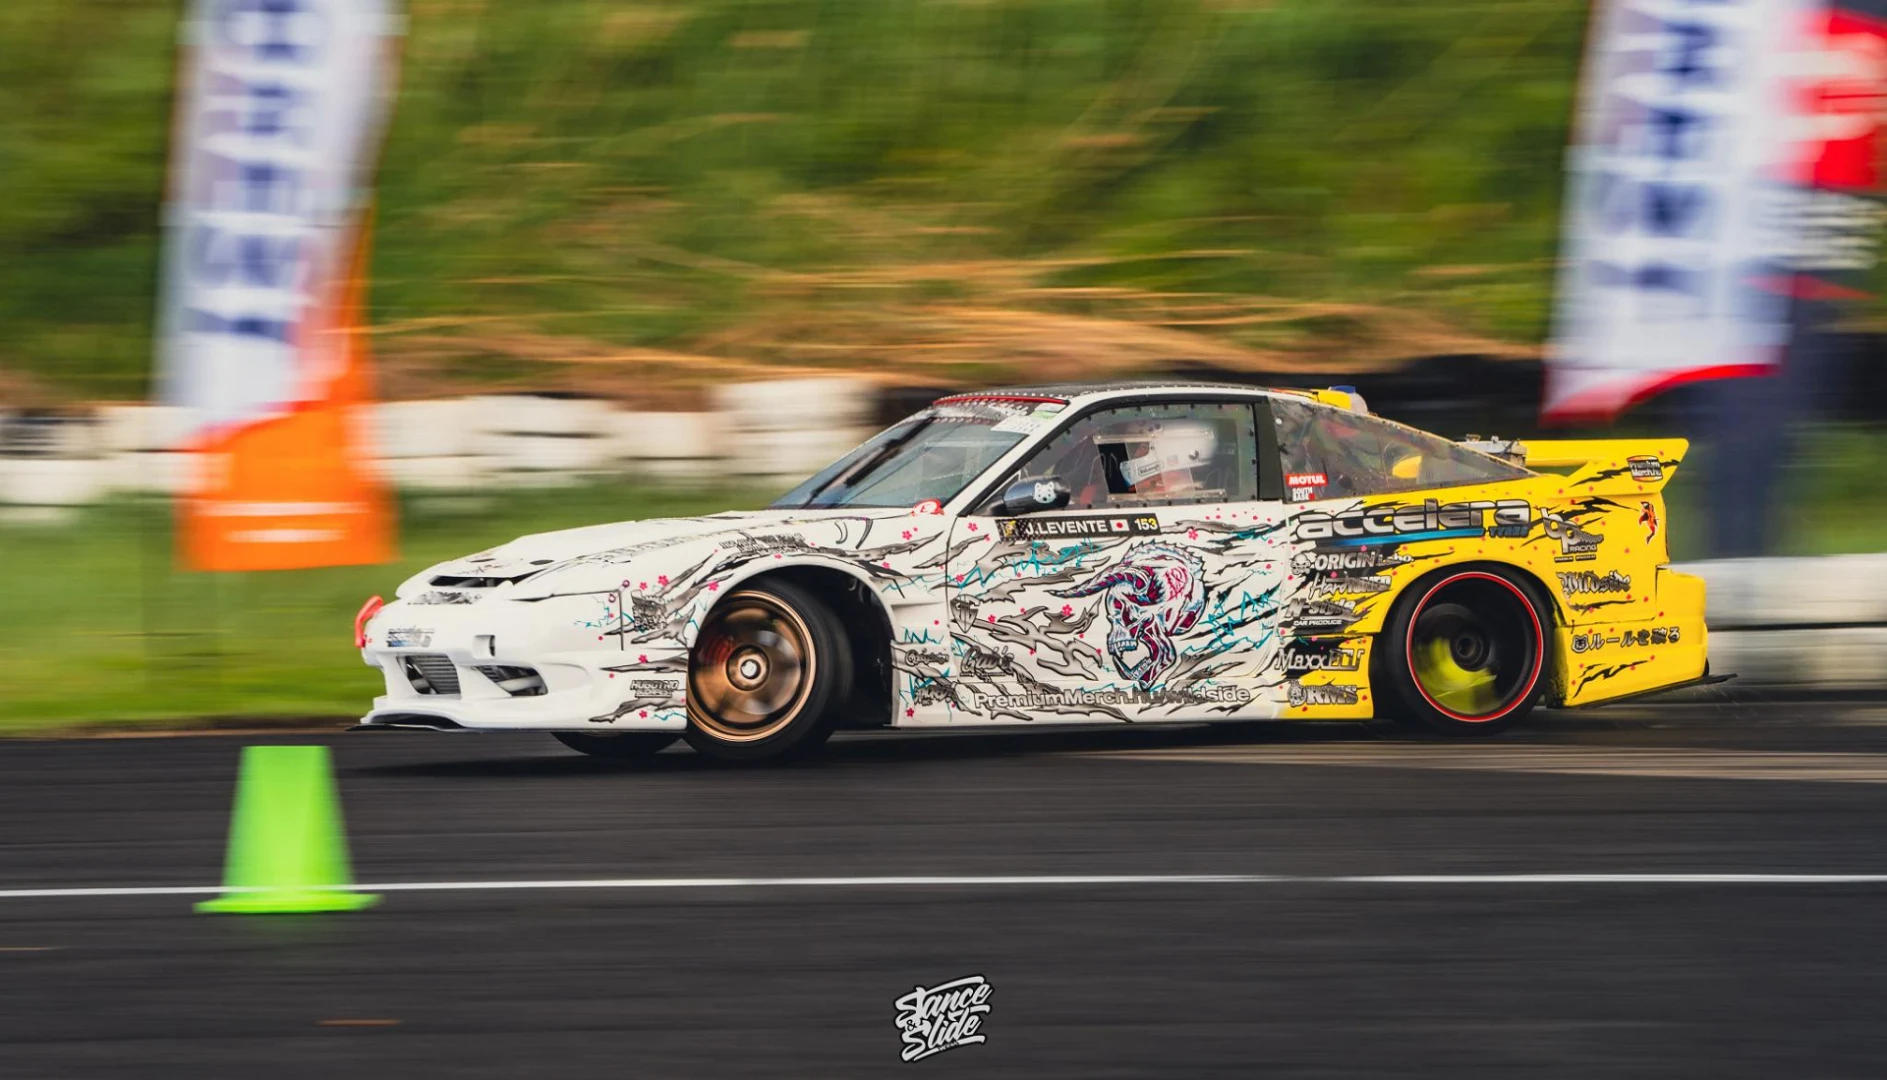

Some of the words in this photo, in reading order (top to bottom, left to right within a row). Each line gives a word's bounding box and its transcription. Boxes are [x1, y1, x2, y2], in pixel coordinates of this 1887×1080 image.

[1289, 475, 1326, 485] MOTUL
[1027, 520, 1108, 535] J.LEVENTE
[1135, 518, 1157, 531] 153
[1296, 499, 1531, 539] accelera
[1489, 526, 1529, 538] TYRES
[1315, 551, 1375, 571] ORIGIN
[974, 685, 1251, 709] PremiumMerch.hu/wildside
